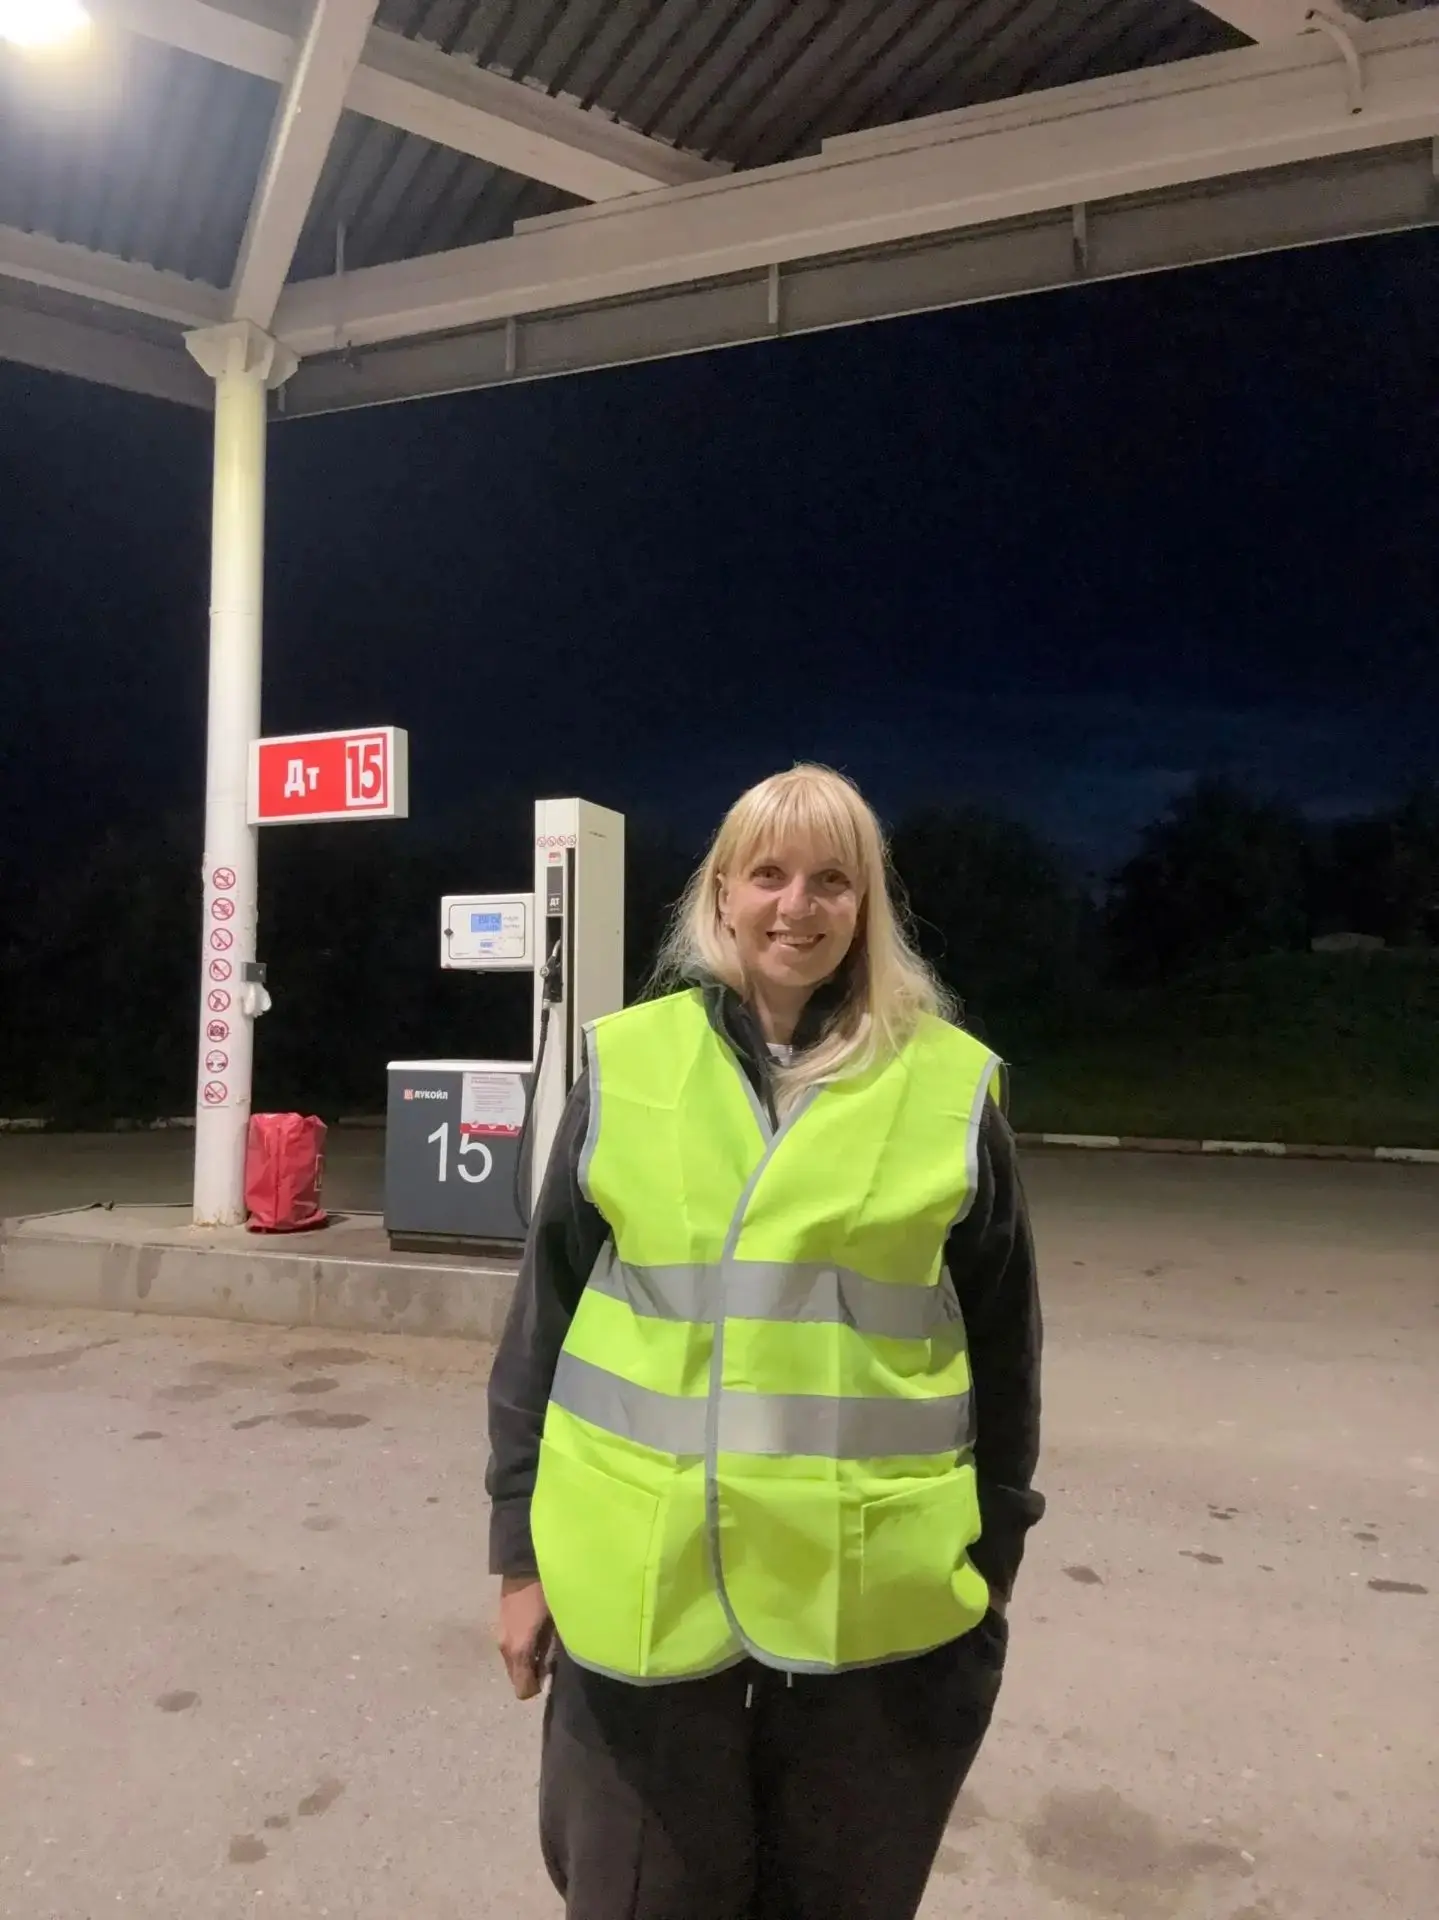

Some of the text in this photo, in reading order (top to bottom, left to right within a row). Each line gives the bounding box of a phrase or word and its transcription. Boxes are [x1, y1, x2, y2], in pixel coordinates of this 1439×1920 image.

[347, 743, 382, 799] 15
[414, 1089, 449, 1100] ЛУКОЙЛ
[427, 1122, 493, 1183] 15
